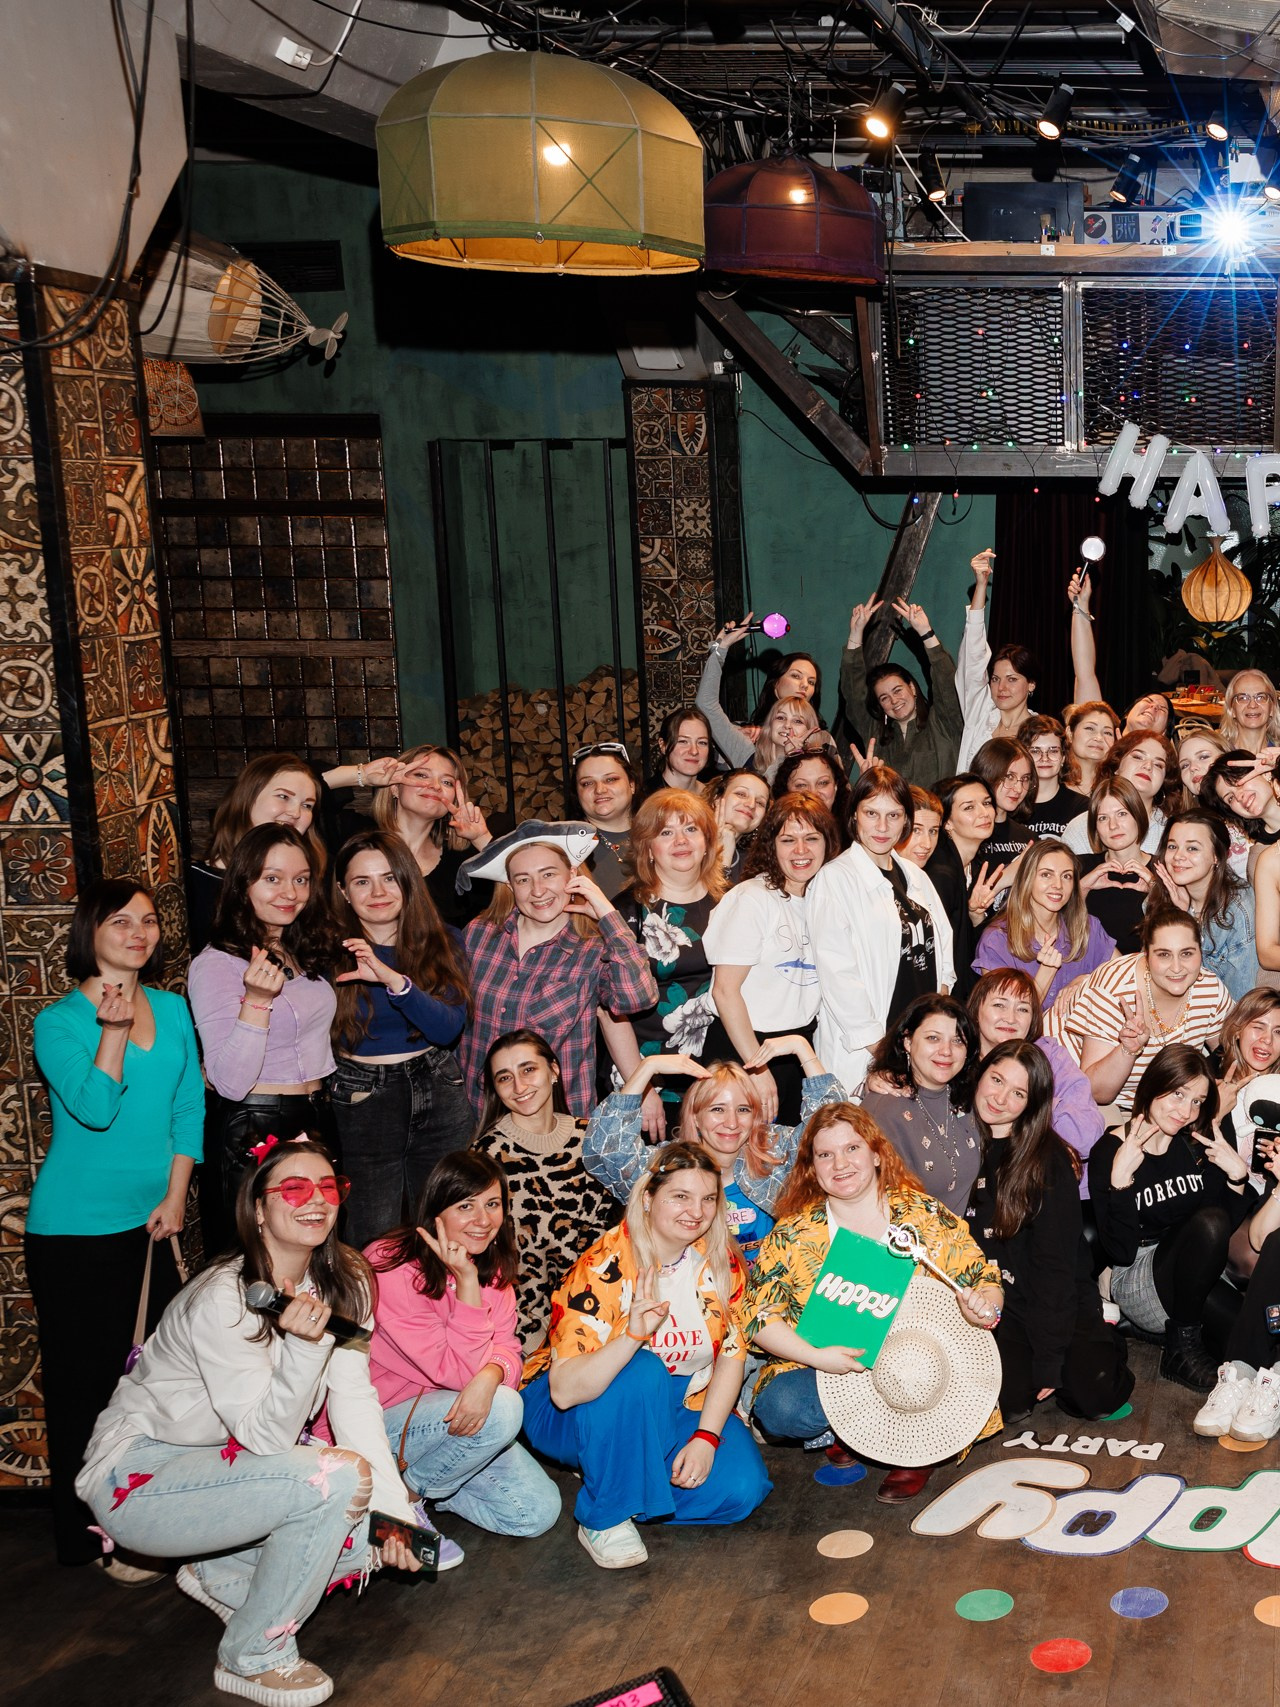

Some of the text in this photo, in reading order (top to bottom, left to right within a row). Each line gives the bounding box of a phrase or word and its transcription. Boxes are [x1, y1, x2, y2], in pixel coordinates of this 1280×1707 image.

[1115, 214, 1136, 223] LITTLE
[650, 1329, 704, 1348] LOVE
[1002, 1431, 1165, 1461] PARTY
